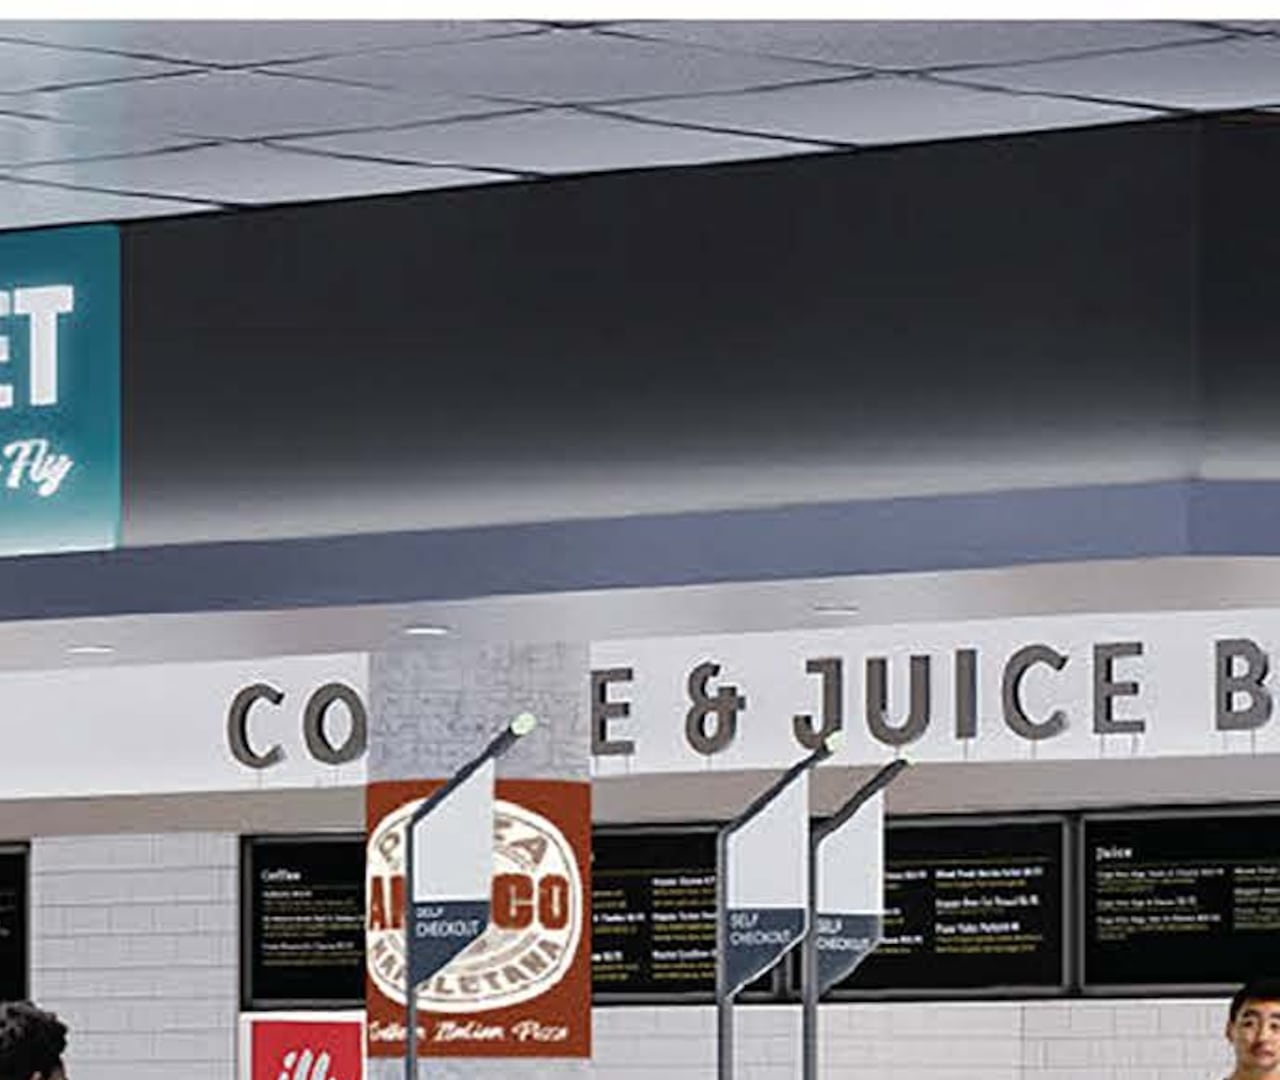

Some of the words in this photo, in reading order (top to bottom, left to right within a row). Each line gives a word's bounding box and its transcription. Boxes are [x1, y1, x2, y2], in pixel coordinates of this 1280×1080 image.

[3, 438, 74, 497] Fly
[685, 661, 746, 756] &
[792, 641, 1146, 752] JUICE
